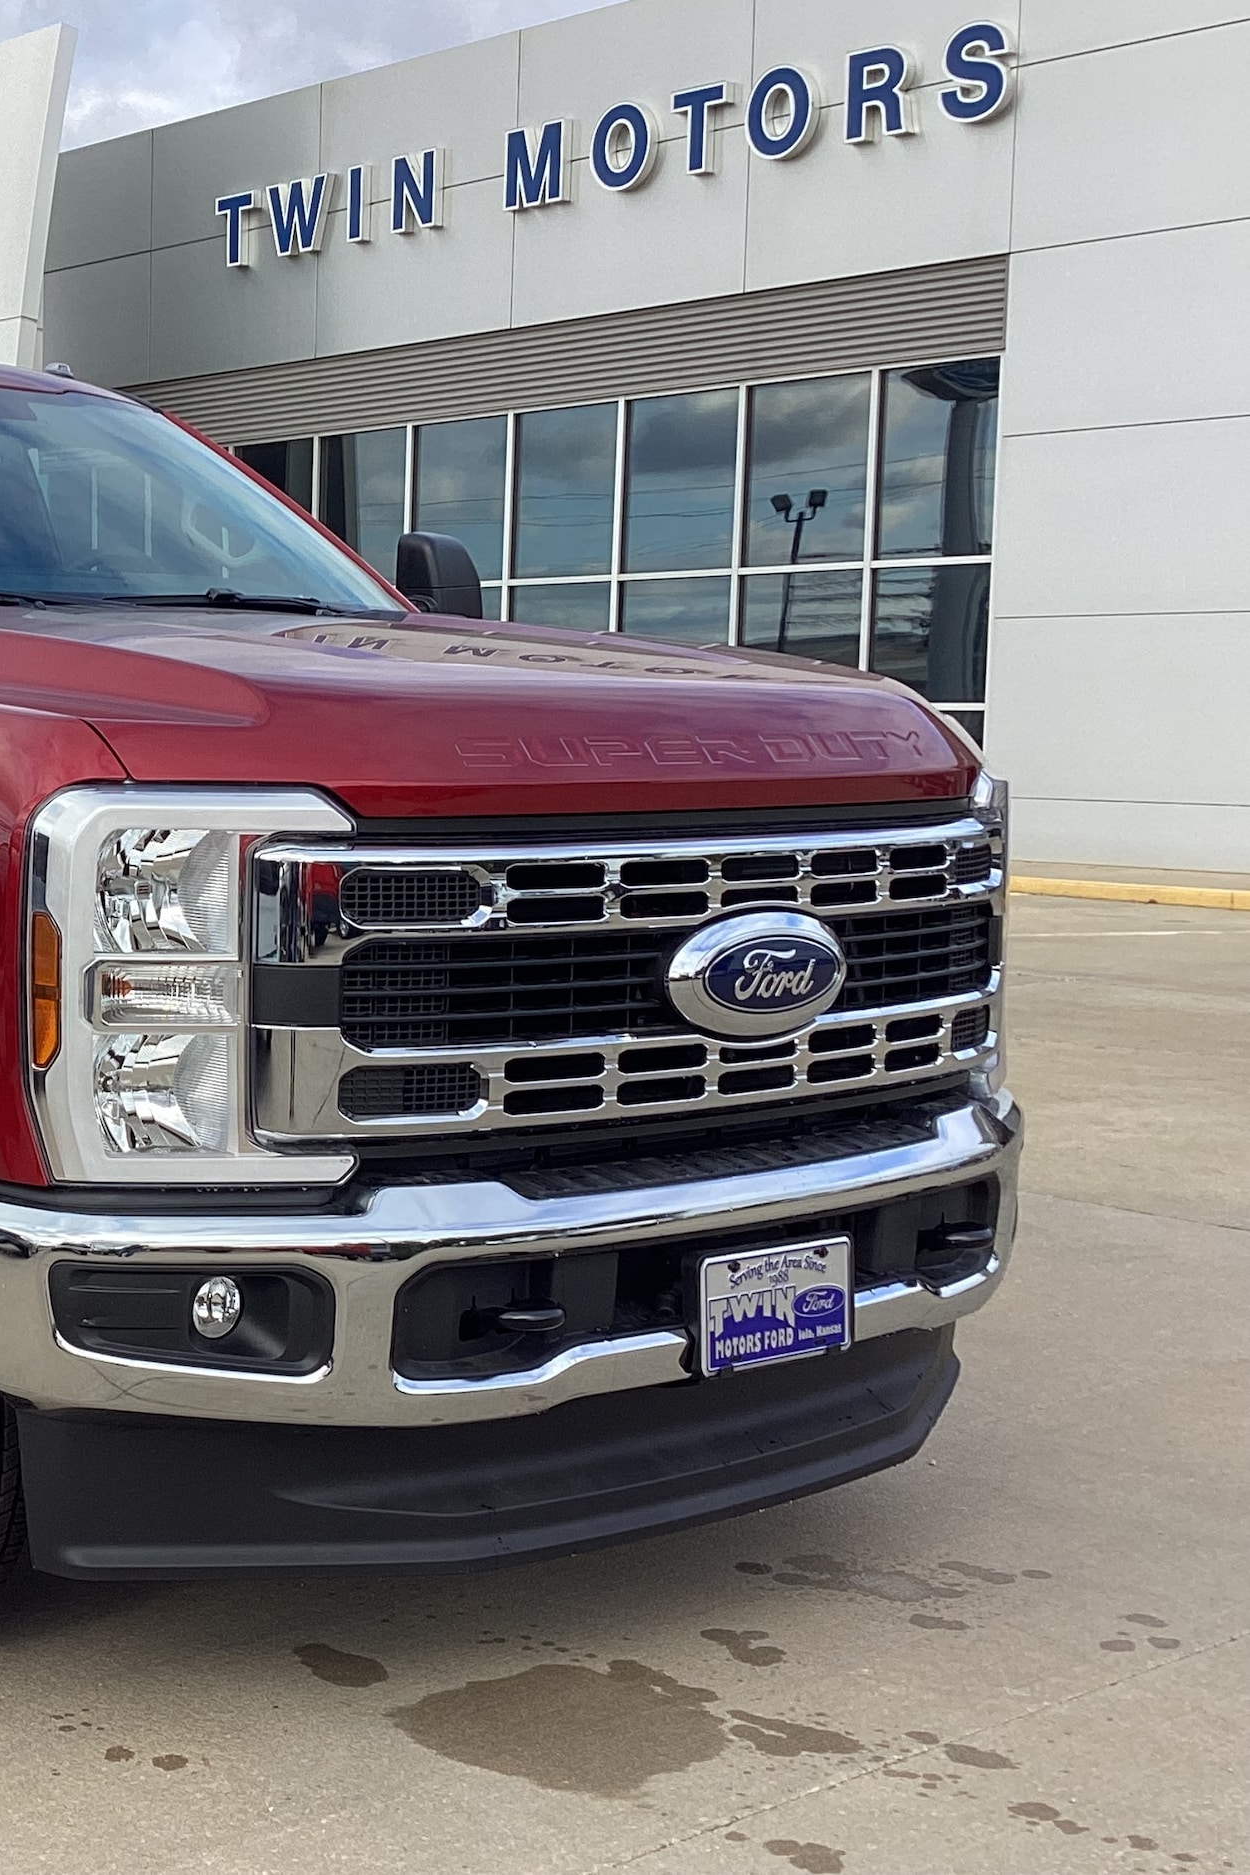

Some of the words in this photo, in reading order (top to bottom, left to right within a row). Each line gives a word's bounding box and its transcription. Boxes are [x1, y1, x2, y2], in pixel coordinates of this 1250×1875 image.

[215, 148, 443, 268] TWIN
[502, 20, 1014, 214] MOTORS
[454, 735, 756, 768] SUPER
[758, 730, 923, 764] DUTY
[734, 948, 817, 1001] Ford
[729, 1264, 763, 1290] Serving
[764, 1255, 780, 1272] the
[780, 1255, 802, 1269] Area
[804, 1255, 827, 1273] Since
[768, 1268, 789, 1287] 1988
[708, 1285, 797, 1338] TWIN
[802, 1291, 835, 1313] Ford
[715, 1331, 762, 1360] MOTORS
[764, 1327, 794, 1350] FORD
